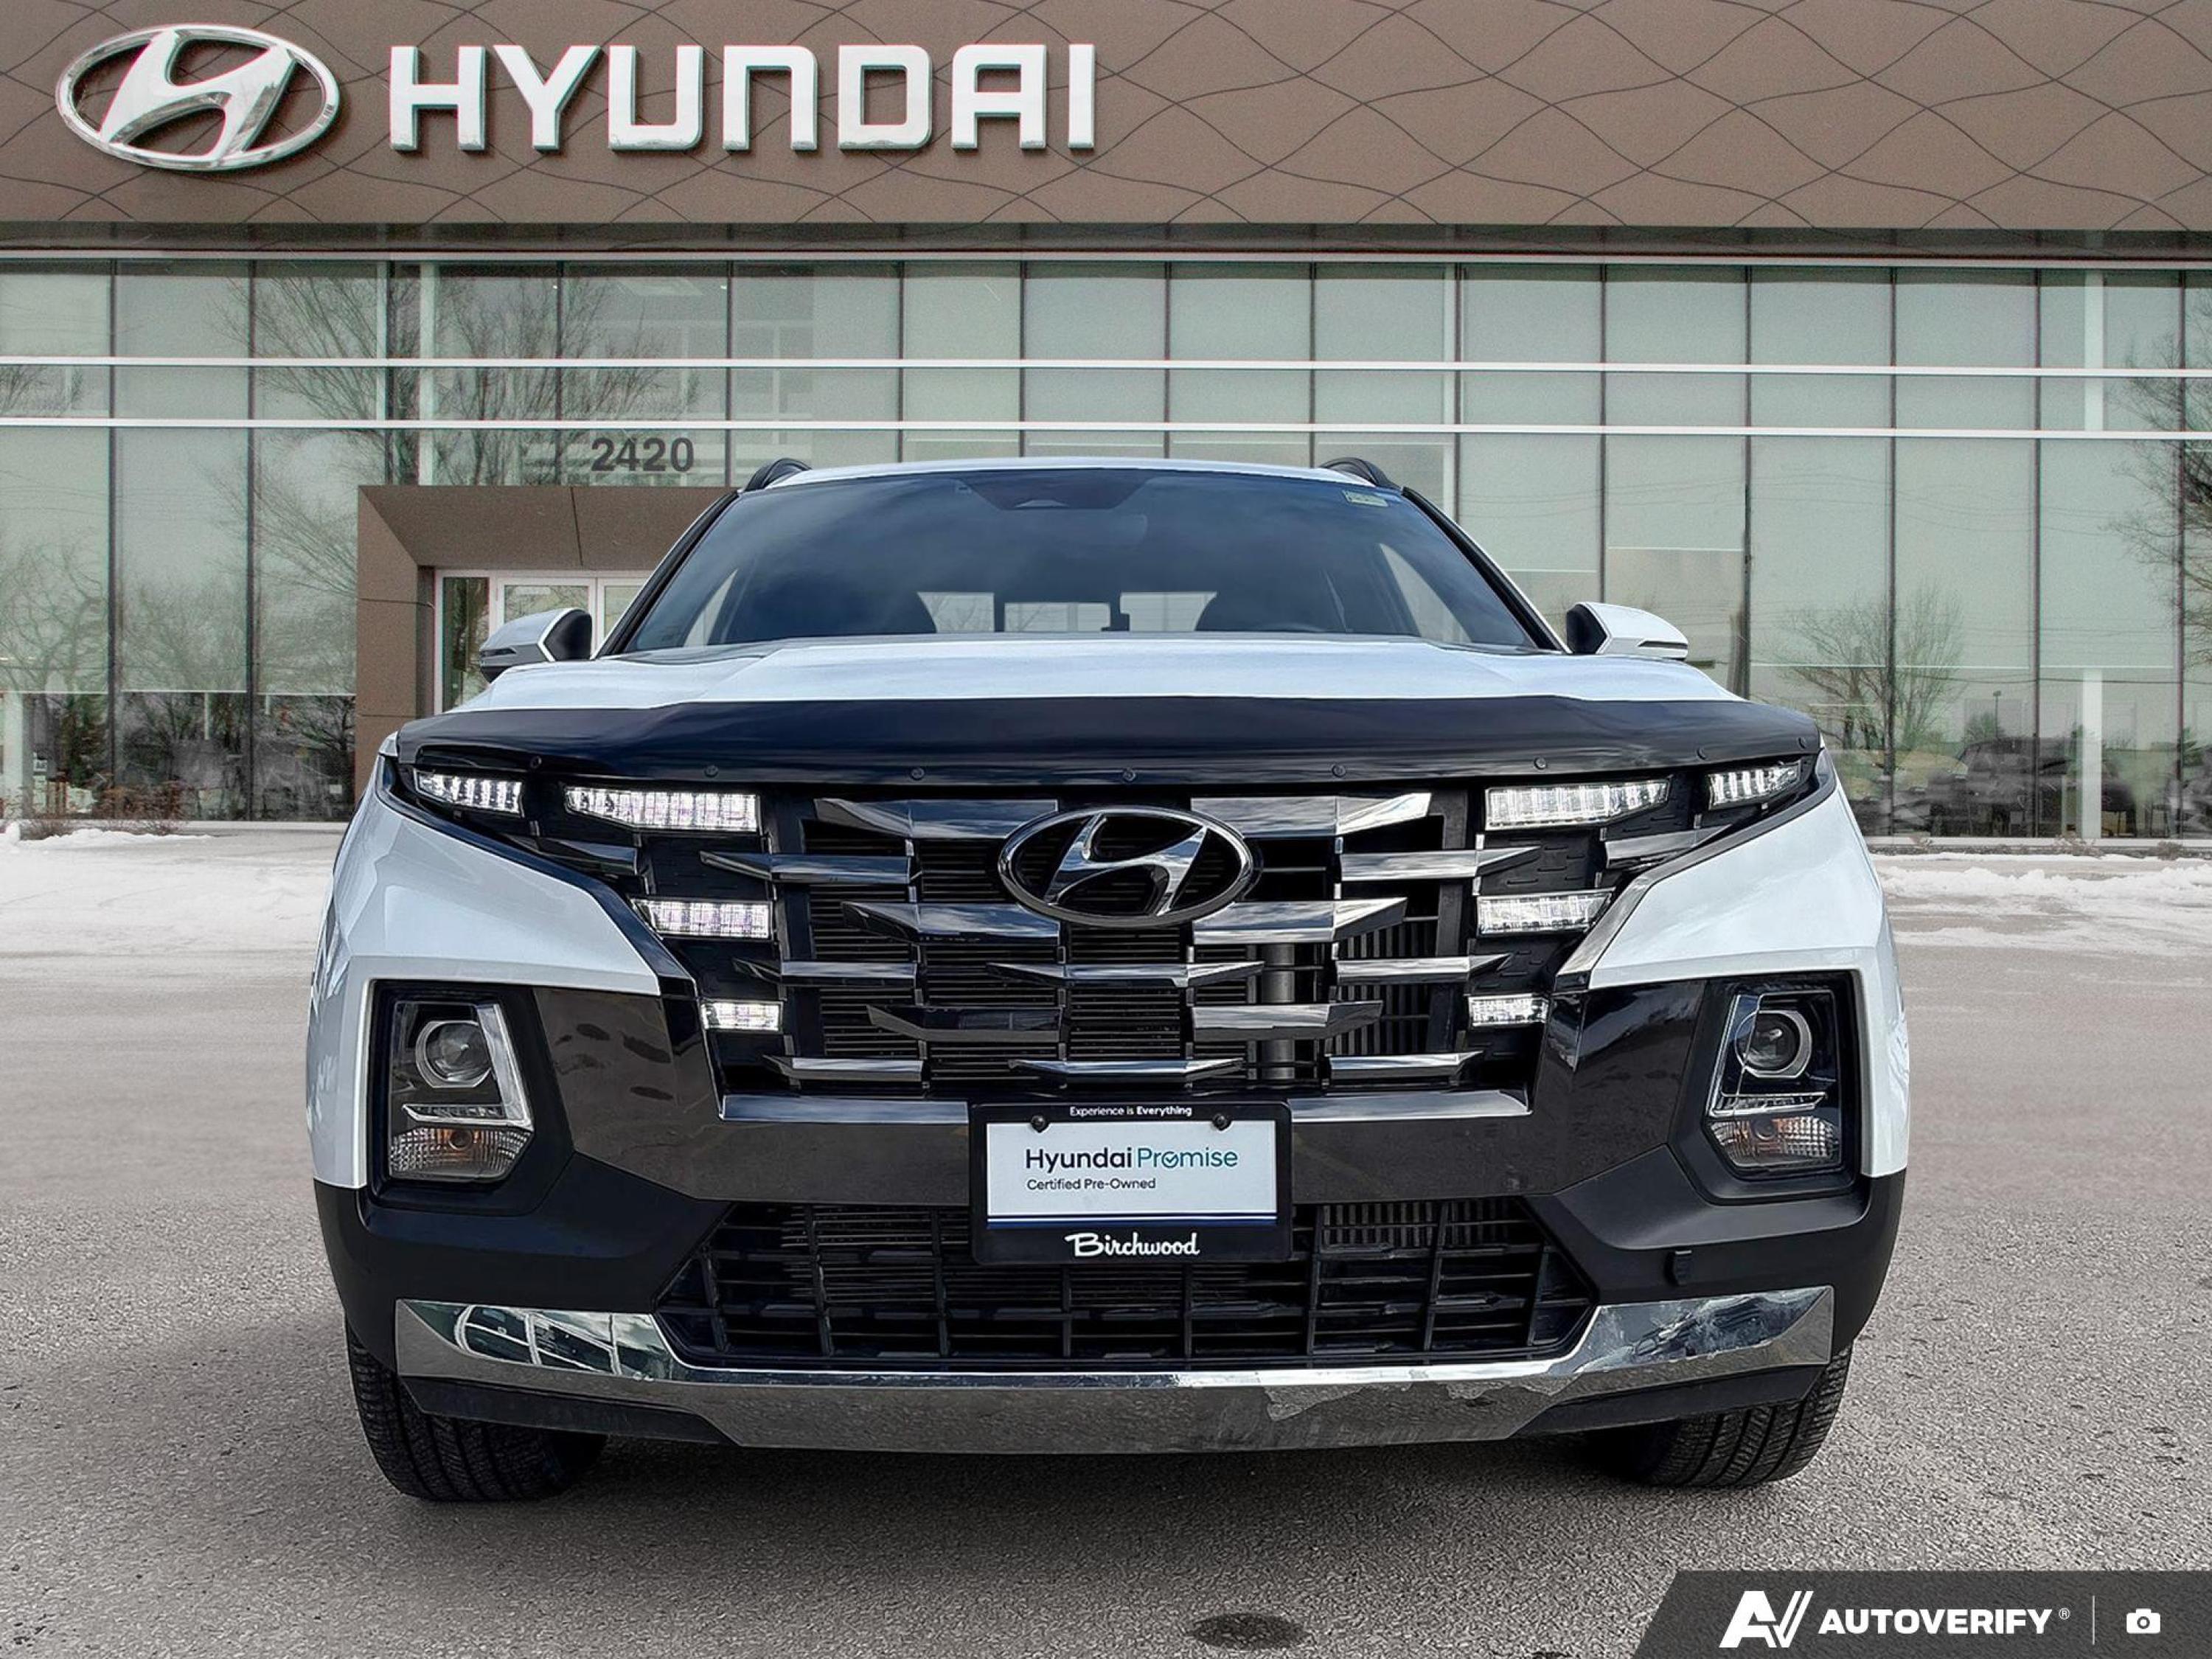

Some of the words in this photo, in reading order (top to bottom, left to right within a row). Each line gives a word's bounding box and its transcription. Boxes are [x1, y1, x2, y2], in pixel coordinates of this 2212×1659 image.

[389, 44, 1096, 153] HYUNDAI
[591, 437, 695, 473] 2420
[1070, 1106, 1125, 1117] Experience
[1126, 1106, 1135, 1116] is
[1136, 1105, 1193, 1117] Everything
[1026, 1147, 1133, 1174] Hyundai
[1138, 1147, 1239, 1169] Promise
[1026, 1178, 1082, 1191] Certified
[1084, 1178, 1156, 1190] Pre-Owned
[1064, 1232, 1200, 1256] Birchwood
